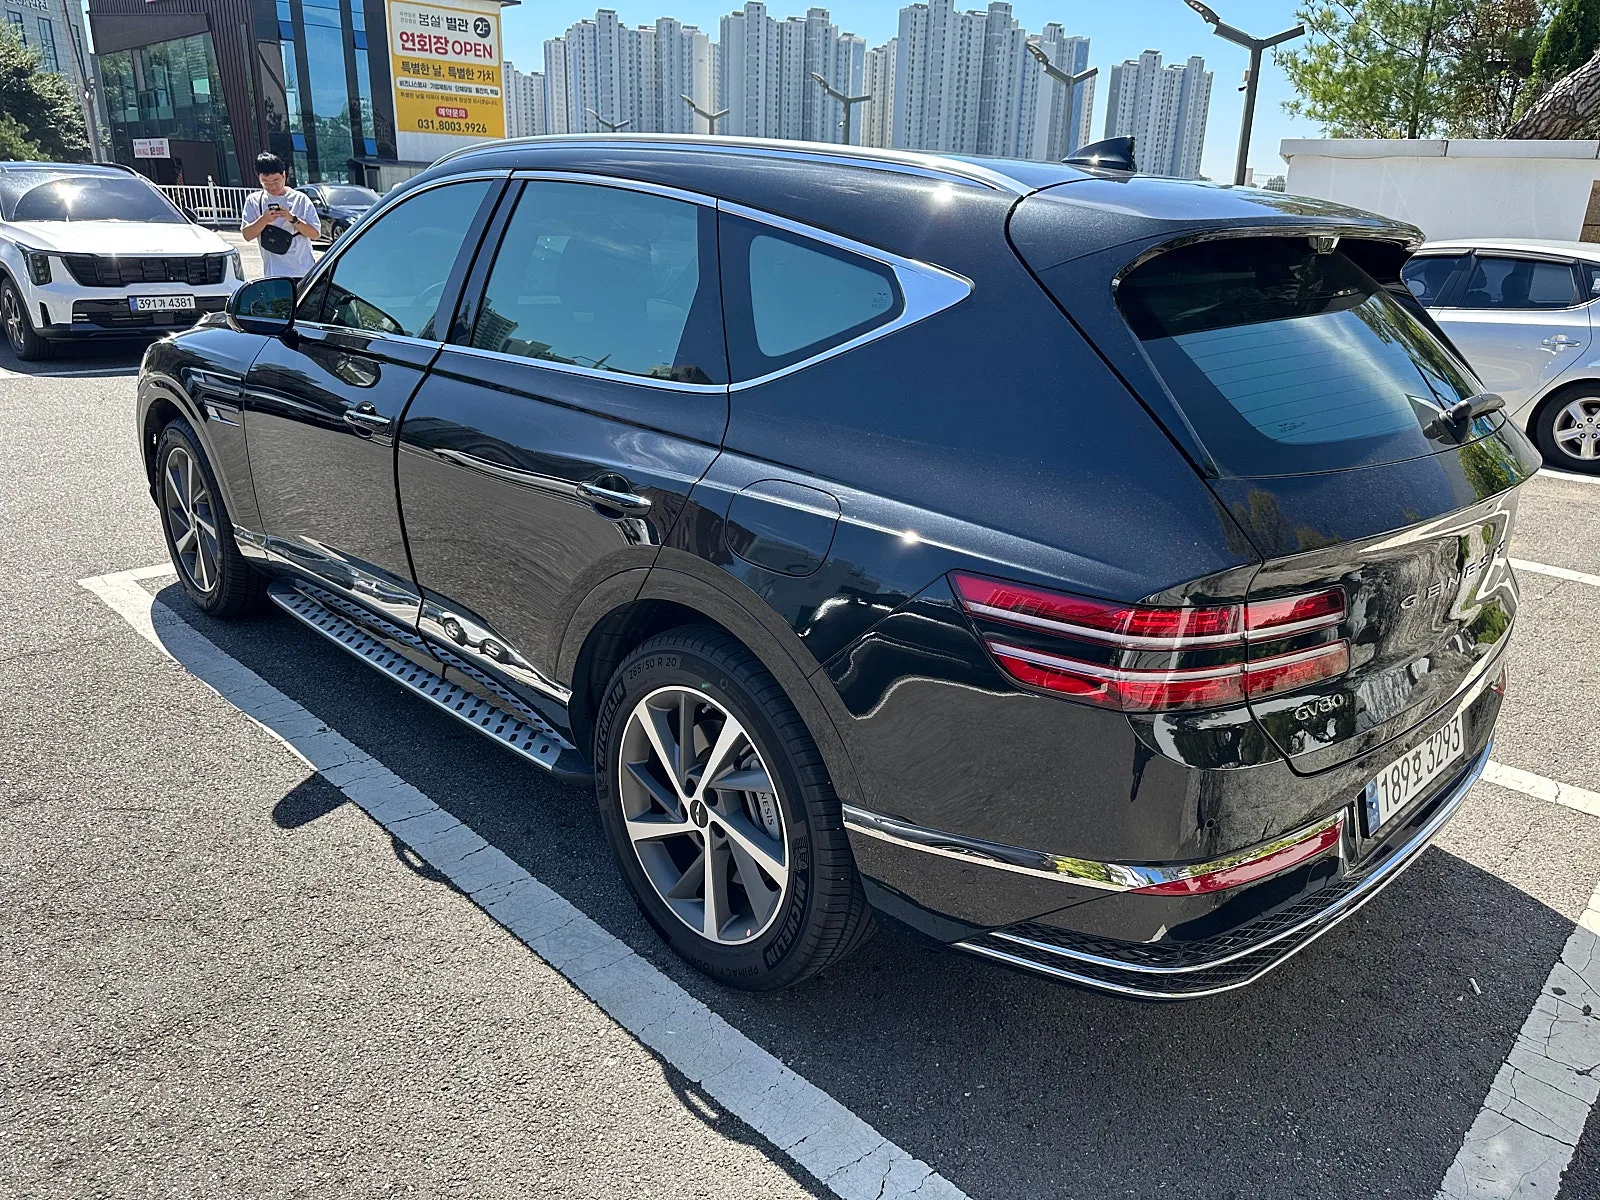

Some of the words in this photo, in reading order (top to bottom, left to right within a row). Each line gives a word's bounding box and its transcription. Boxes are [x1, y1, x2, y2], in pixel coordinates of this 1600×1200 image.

[446, 16, 469, 32] 별관
[475, 21, 489, 34] 2F
[399, 31, 449, 55] 연회장
[451, 40, 493, 59] OPEN
[401, 61, 430, 76] 특별한
[432, 64, 445, 78] 날,
[448, 66, 474, 80] 특별한
[477, 69, 494, 82] 가치
[438, 107, 466, 118] 예약문의
[417, 118, 487, 133] 031.8003.9926
[168, 297, 192, 308] 4381
[1400, 539, 1506, 609] GENESIS
[628, 657, 655, 680] 265/50
[657, 657, 663, 667] R
[665, 657, 677, 667] 20
[1294, 692, 1344, 721] GV80
[597, 681, 625, 768] MICHELIN
[1381, 749, 1423, 813] 189호
[1425, 715, 1461, 775] 3293
[766, 874, 807, 967] MICHELIN
[719, 964, 759, 978] PRIMACY
